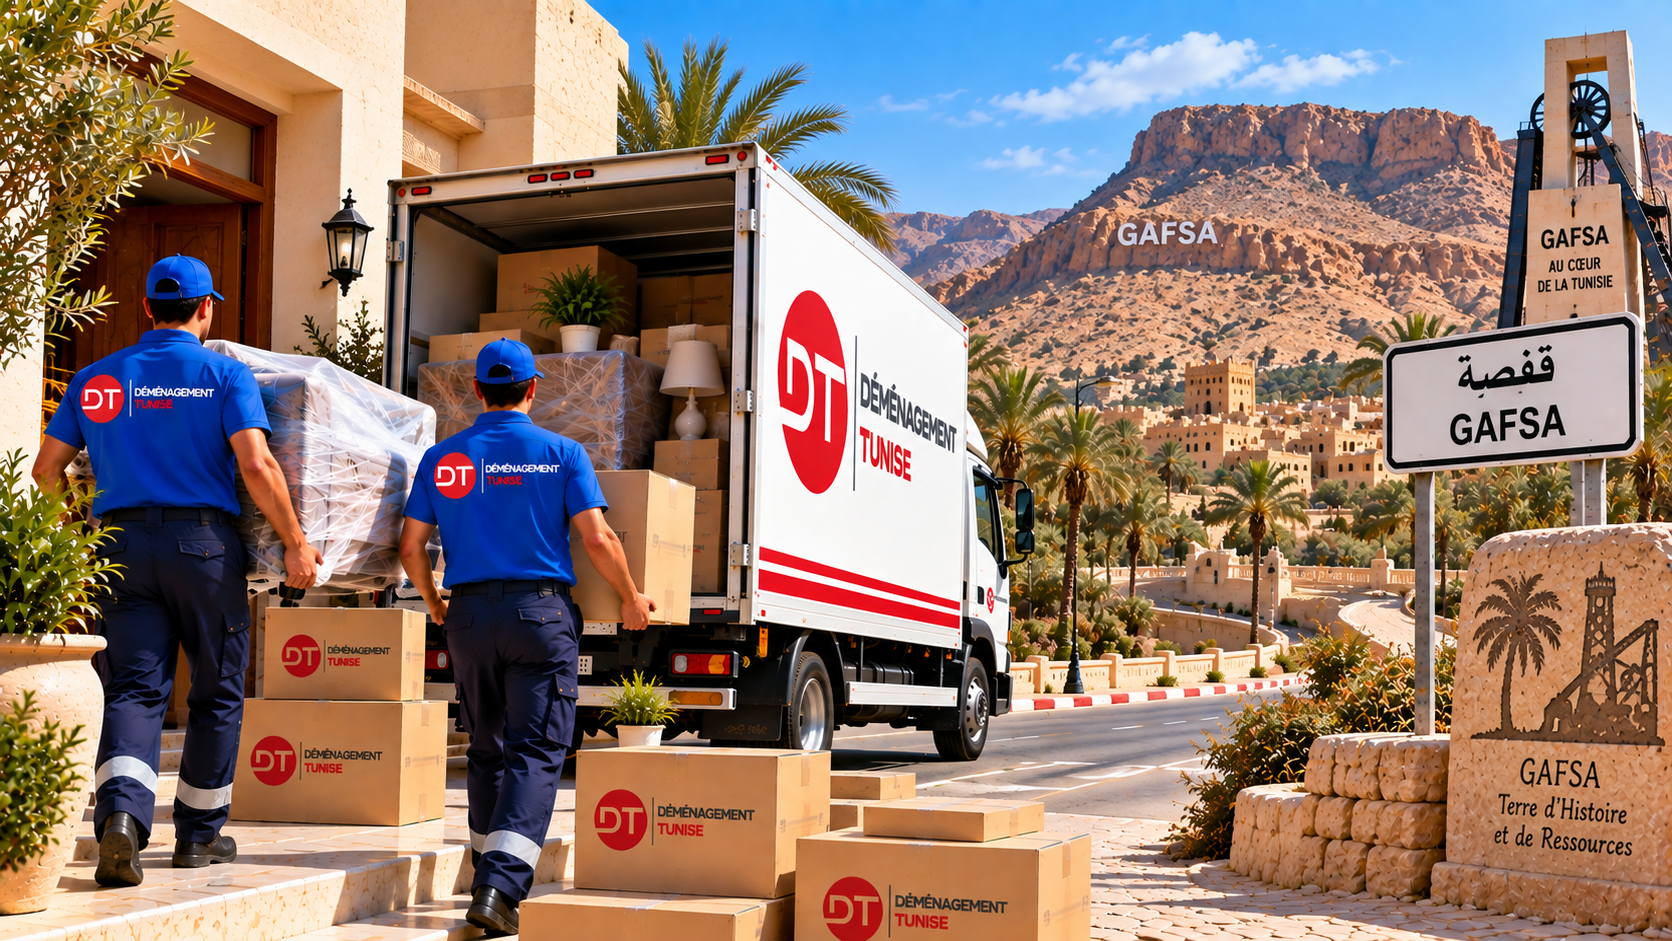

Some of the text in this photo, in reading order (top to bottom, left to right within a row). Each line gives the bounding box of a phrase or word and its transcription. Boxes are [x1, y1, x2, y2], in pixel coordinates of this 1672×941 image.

[1117, 221, 1218, 246] GAFSA
[1541, 225, 1609, 249] GAFSA
[1549, 257, 1601, 273] AU CŒUR
[1538, 275, 1613, 293] DE LA TUNISIE
[82, 389, 121, 410] DT
[134, 386, 214, 398] DÉMÉNAGEMENT
[780, 337, 846, 443] DT
[860, 371, 957, 453] DÉMÉNAGEMENT
[1450, 404, 1566, 446] GAFSA
[859, 426, 912, 482] TUNISE
[436, 466, 474, 487] DT
[485, 463, 560, 474] DÉMÉNAGEMENT
[282, 646, 319, 667] DT
[327, 657, 361, 667] TUNISE
[251, 750, 294, 772] DT
[304, 748, 383, 761] DÉMÉNAGEMENT
[304, 762, 343, 774] TUNISE
[1520, 757, 1601, 788] GAFSA
[657, 803, 756, 821] DÉMÉNAGEMENT
[1498, 793, 1628, 824] Terre d'Histoire
[594, 806, 645, 835] DT
[657, 823, 704, 837] TUNISE
[1494, 824, 1633, 857] et de Ressources
[823, 894, 880, 927] DT
[894, 892, 1009, 914] DÉMÉNAGEMENT
[894, 912, 949, 930] TUNISE
